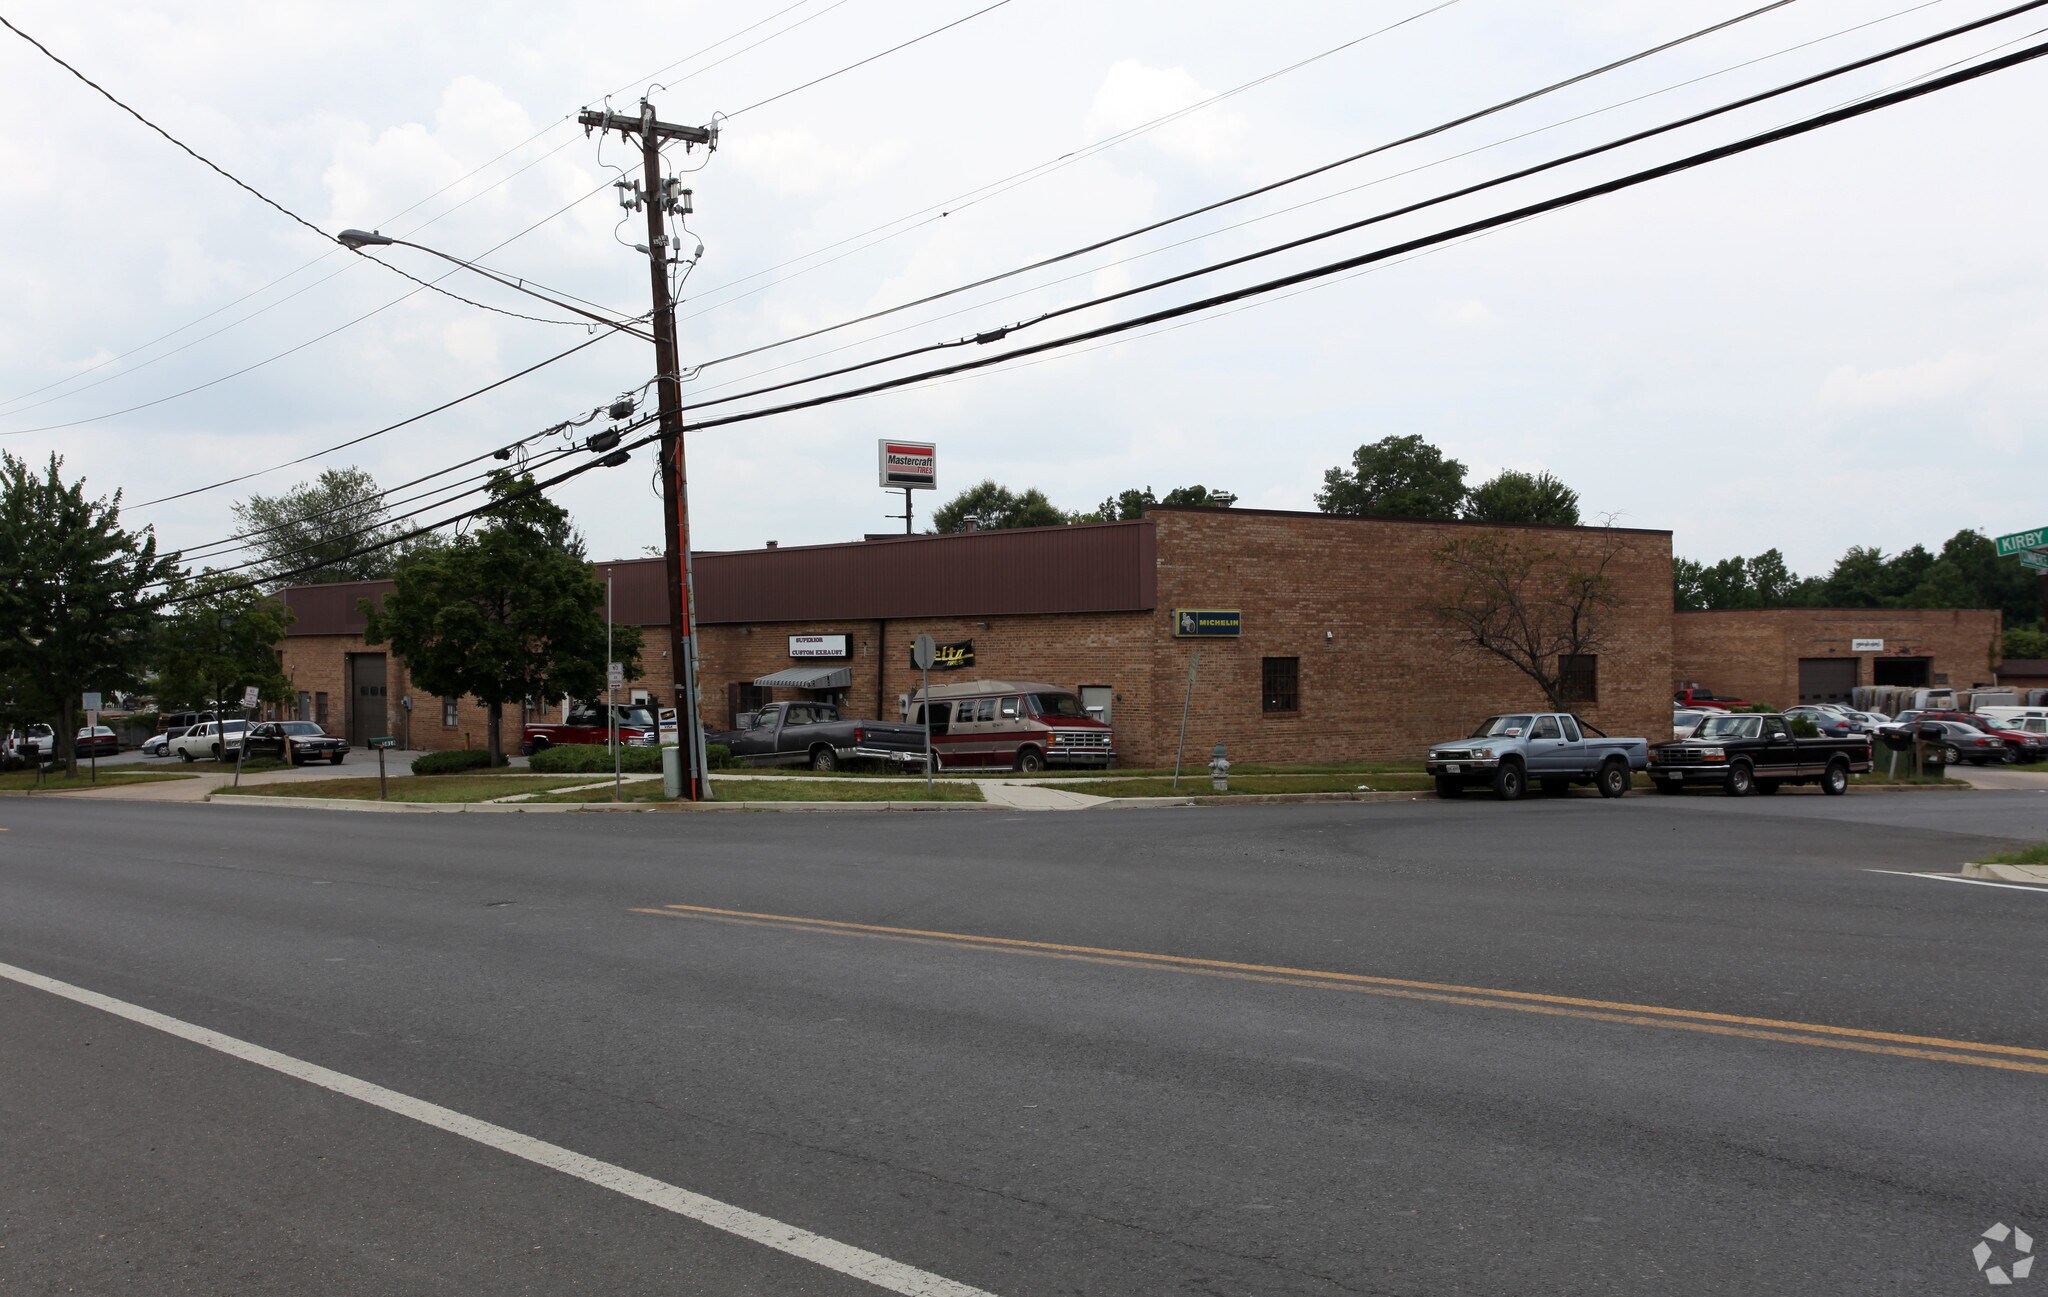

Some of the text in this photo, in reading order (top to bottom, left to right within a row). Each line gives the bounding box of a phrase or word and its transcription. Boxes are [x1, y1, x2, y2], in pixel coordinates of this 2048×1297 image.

[888, 455, 933, 466] Mastercraft
[917, 466, 933, 474] TIRES
[2001, 530, 2044, 551] KIRBY
